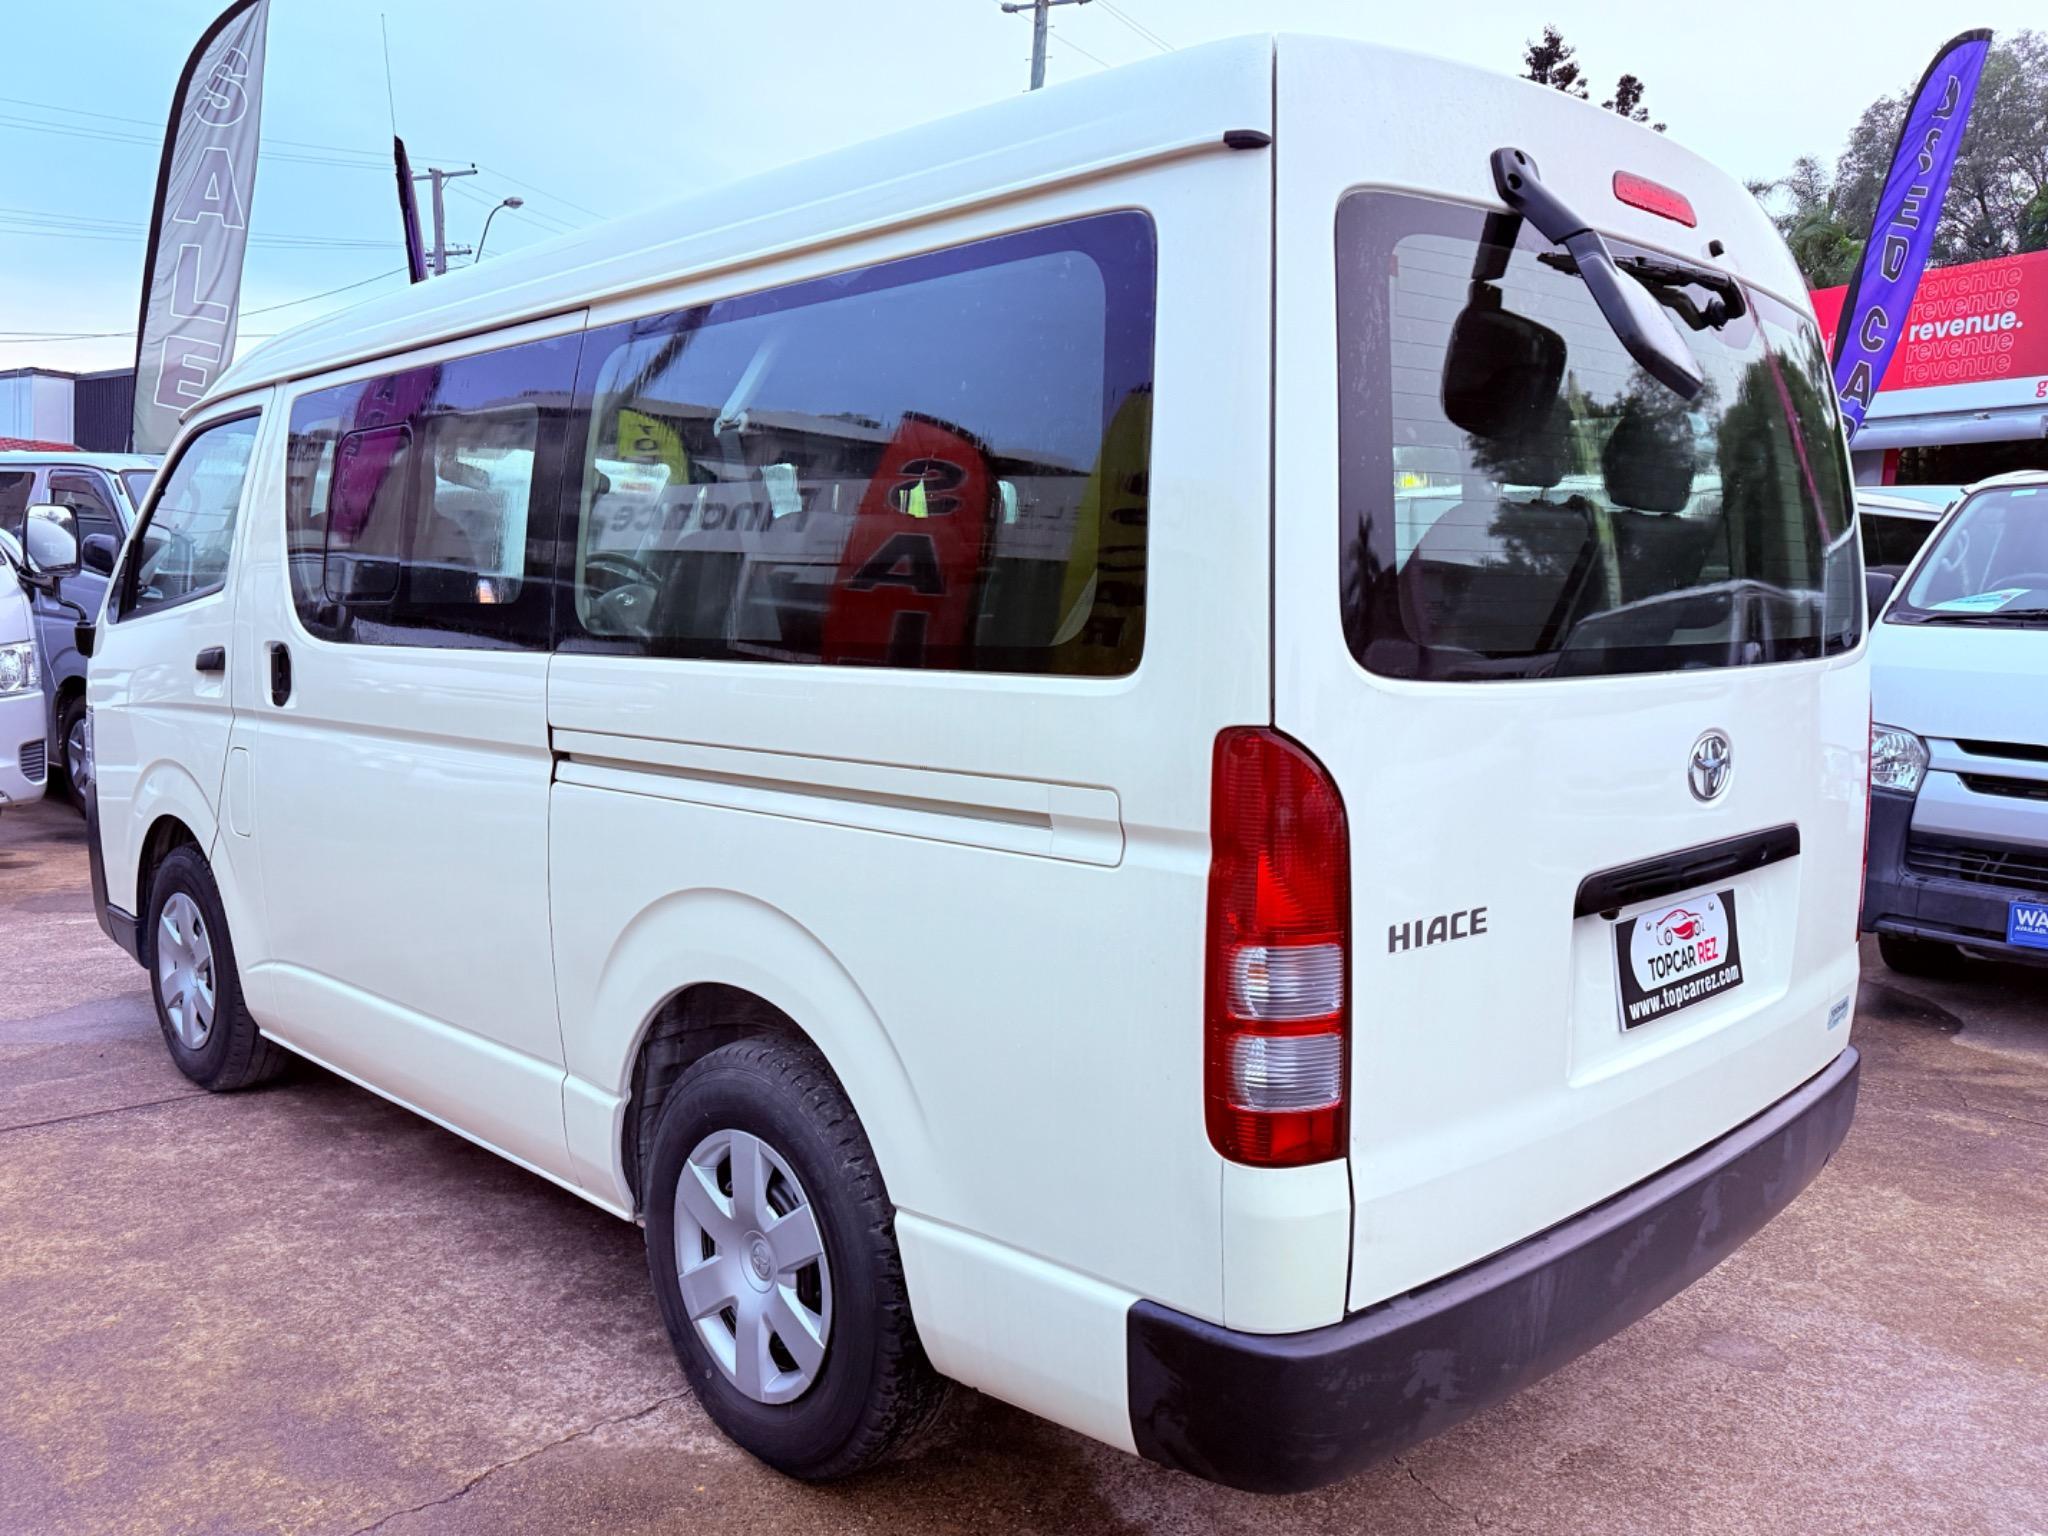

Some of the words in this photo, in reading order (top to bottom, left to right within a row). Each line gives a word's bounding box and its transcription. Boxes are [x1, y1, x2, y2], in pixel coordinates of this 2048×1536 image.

[154, 46, 249, 412] SALE
[1911, 289, 2020, 322] revenue
[1908, 310, 2023, 342] revenue.
[1905, 332, 2014, 363] revenue
[1903, 354, 2012, 384] revenue
[1388, 906, 1488, 954] HIACE
[1647, 944, 1697, 981] TOPCAR
[1697, 936, 1719, 964] REZ
[1628, 964, 1740, 1021] www.topcarrez.com
